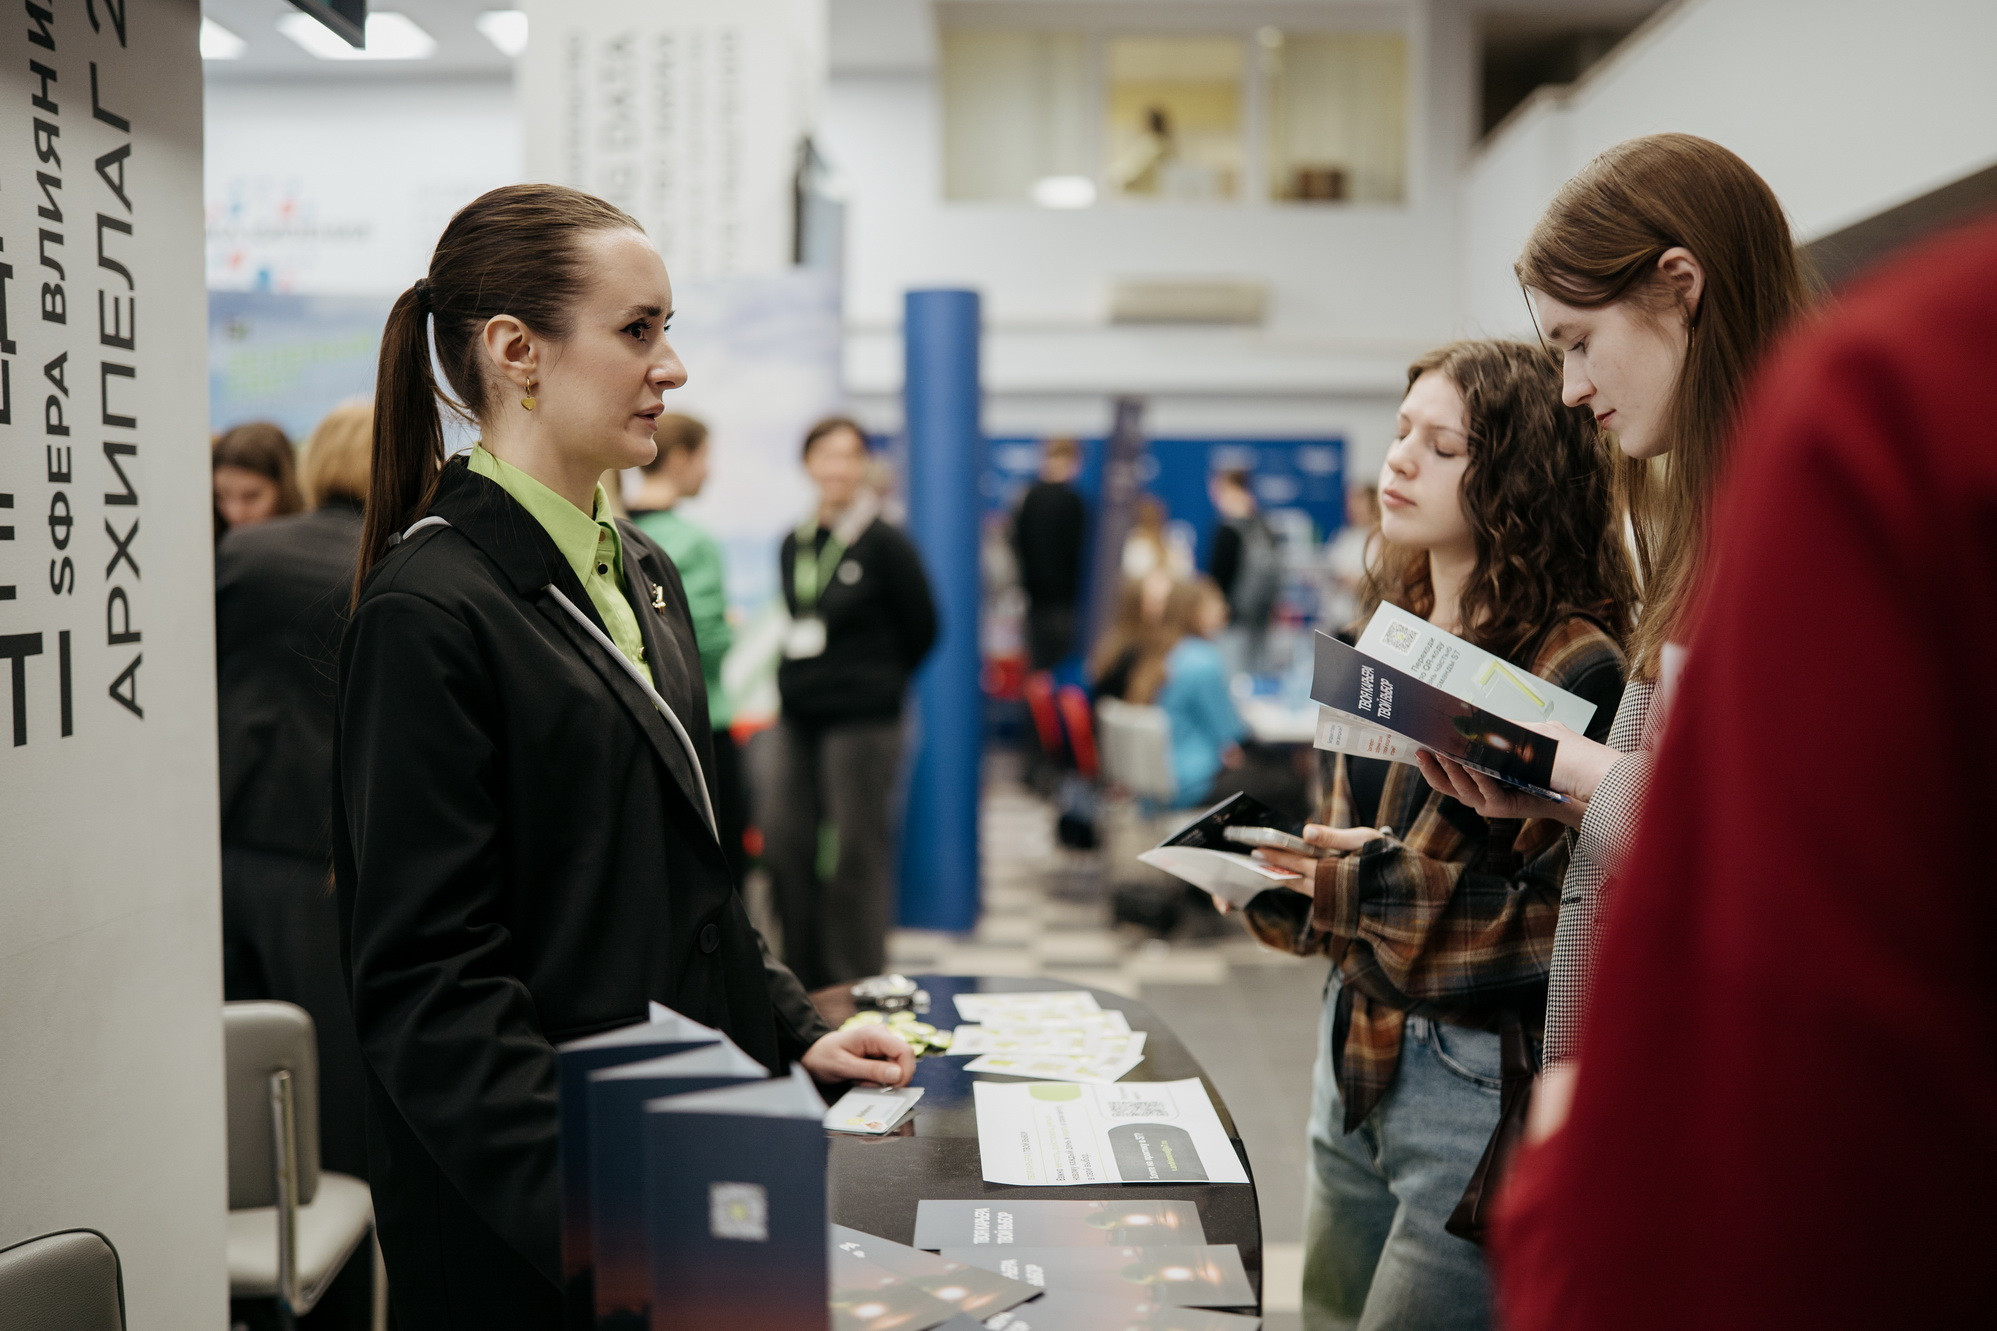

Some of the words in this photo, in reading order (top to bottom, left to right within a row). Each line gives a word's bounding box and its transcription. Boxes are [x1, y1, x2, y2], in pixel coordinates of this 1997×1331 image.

[25, 0, 67, 325] ВЛИЯНИ
[89, 60, 144, 720] АРХИПЕЛАГ
[1411, 637, 1435, 672] Переходи
[1423, 641, 1445, 671] QR-коду
[1361, 665, 1374, 695] КАРЬЕРА
[1437, 661, 1456, 688] оманды
[1358, 691, 1373, 711] ТВОЯ
[1380, 678, 1393, 702] ВЫБОР
[1376, 698, 1392, 719] ТВОЙ
